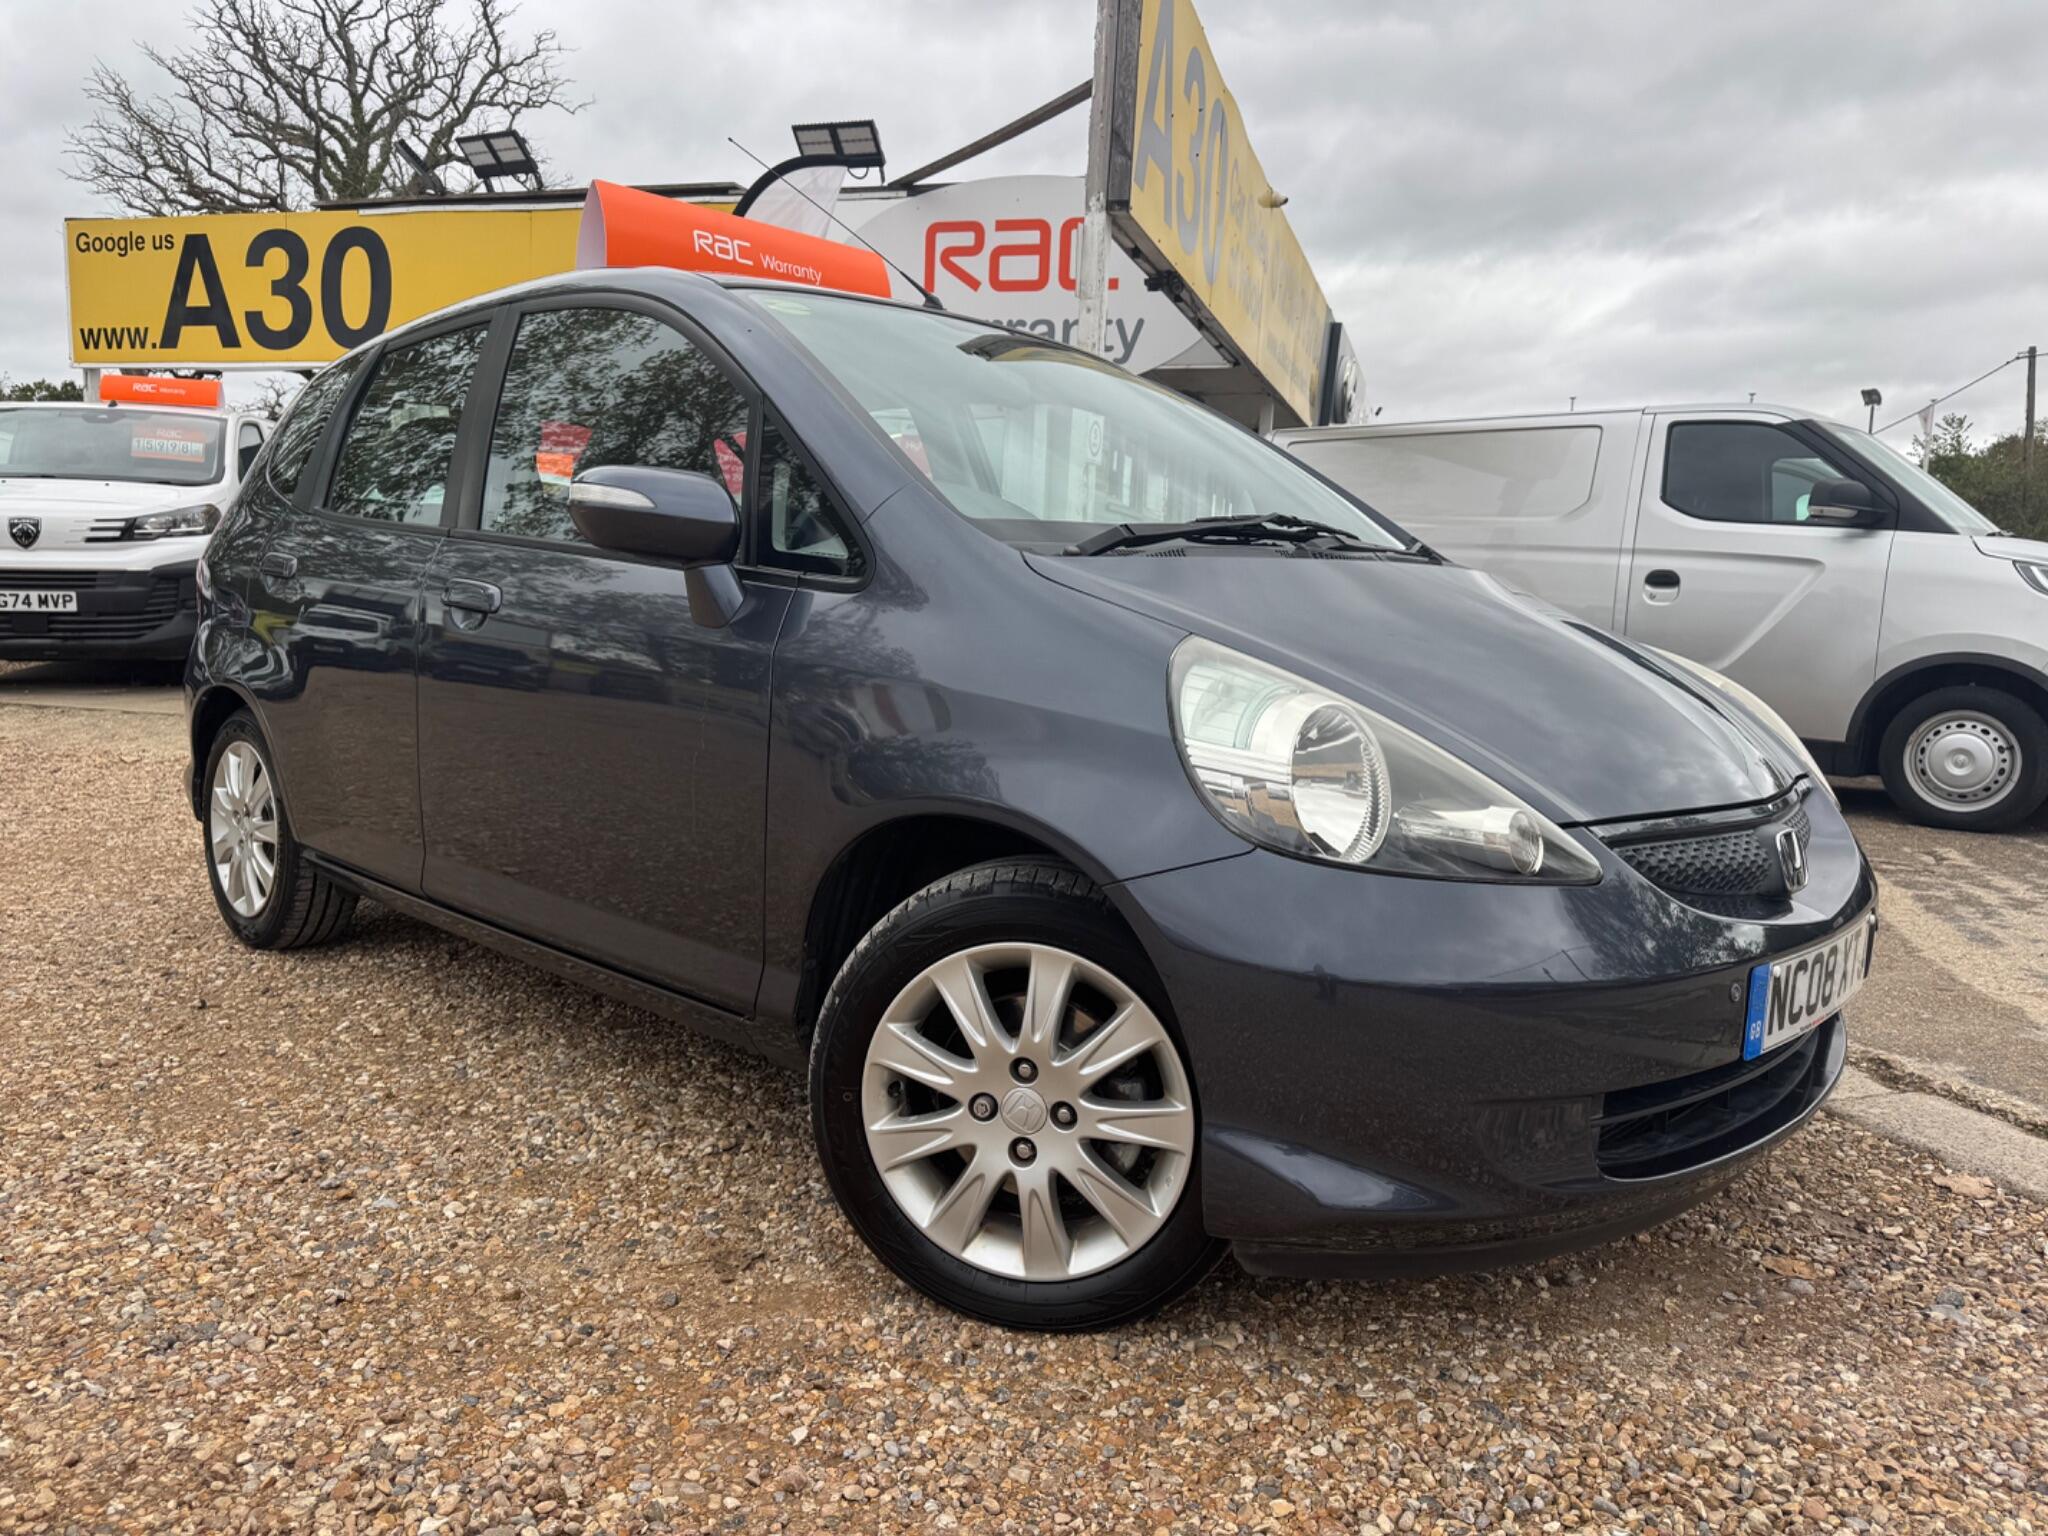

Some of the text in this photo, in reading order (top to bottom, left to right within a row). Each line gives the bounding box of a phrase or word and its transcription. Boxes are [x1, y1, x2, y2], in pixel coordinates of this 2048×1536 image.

[1134, 0, 1229, 287] A30
[75, 231, 175, 258] Google us
[760, 252, 822, 287] Warranty
[37, 593, 74, 609] MVP
[1767, 944, 1838, 1037] NC08
